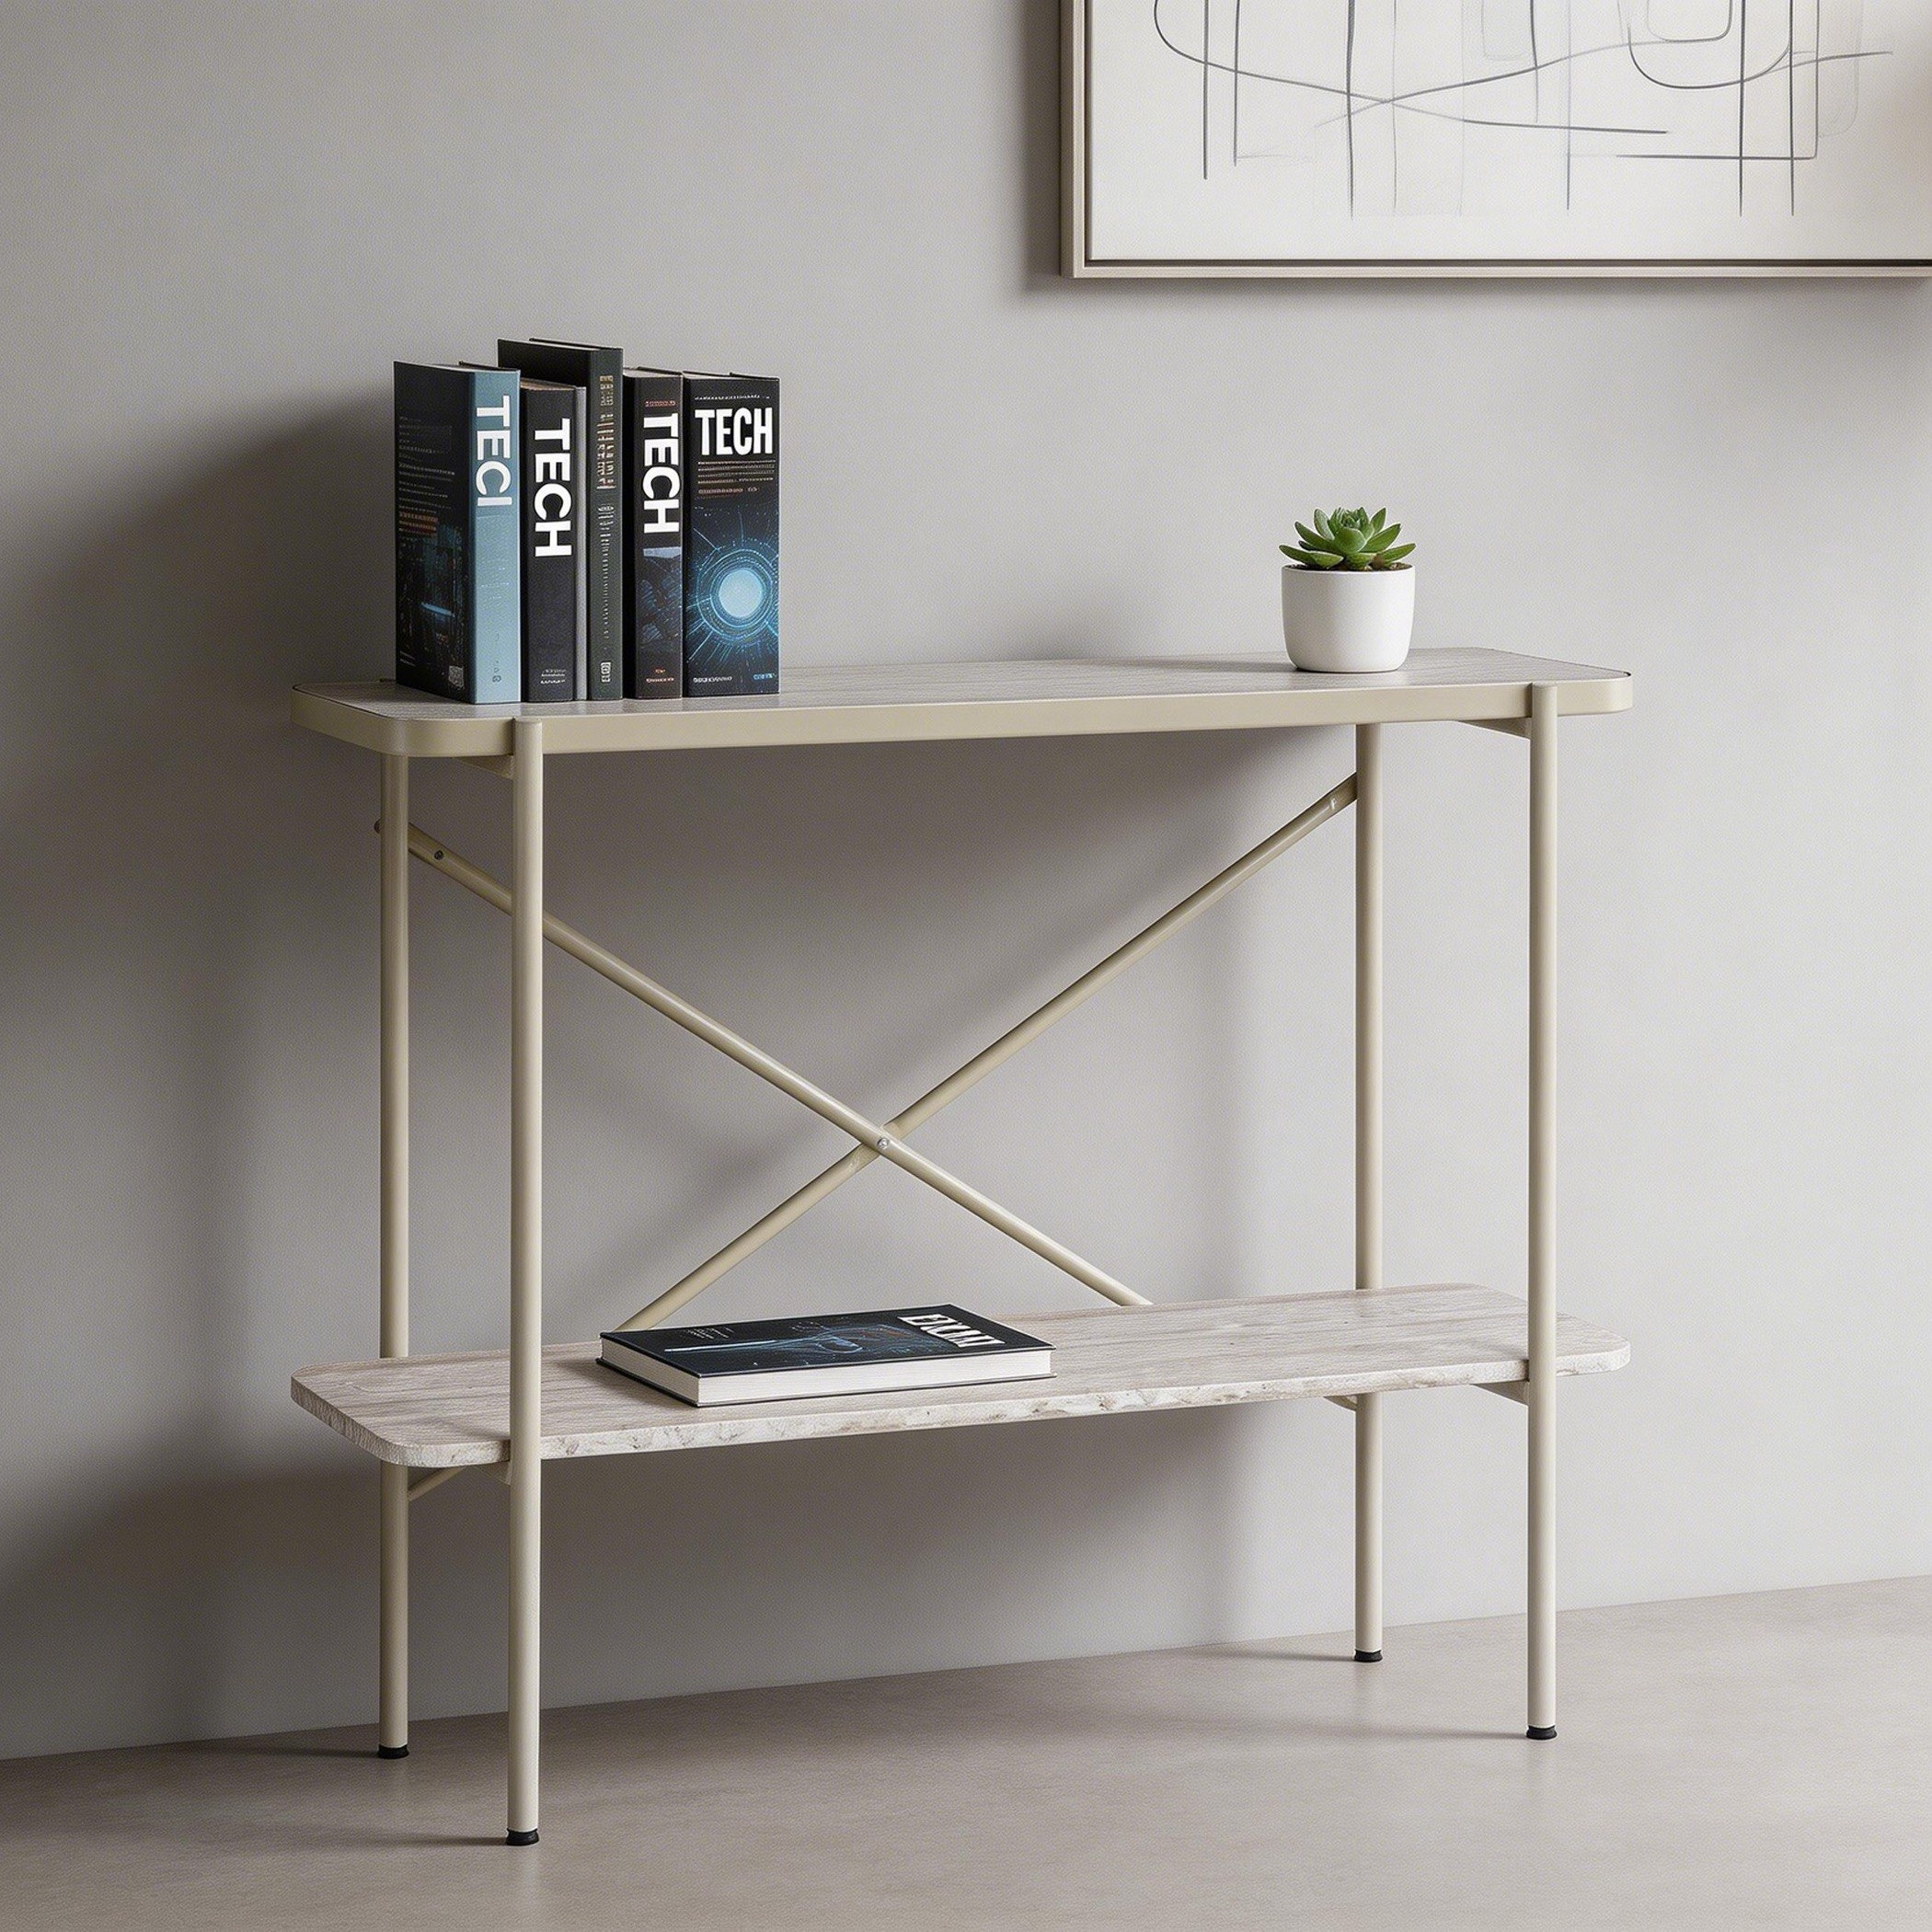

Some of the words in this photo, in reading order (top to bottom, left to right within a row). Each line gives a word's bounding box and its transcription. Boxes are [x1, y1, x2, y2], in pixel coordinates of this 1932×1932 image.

[476, 395, 512, 507] TECI
[534, 418, 572, 558] TECH
[642, 412, 681, 534] TECH
[695, 407, 773, 455] TECH
